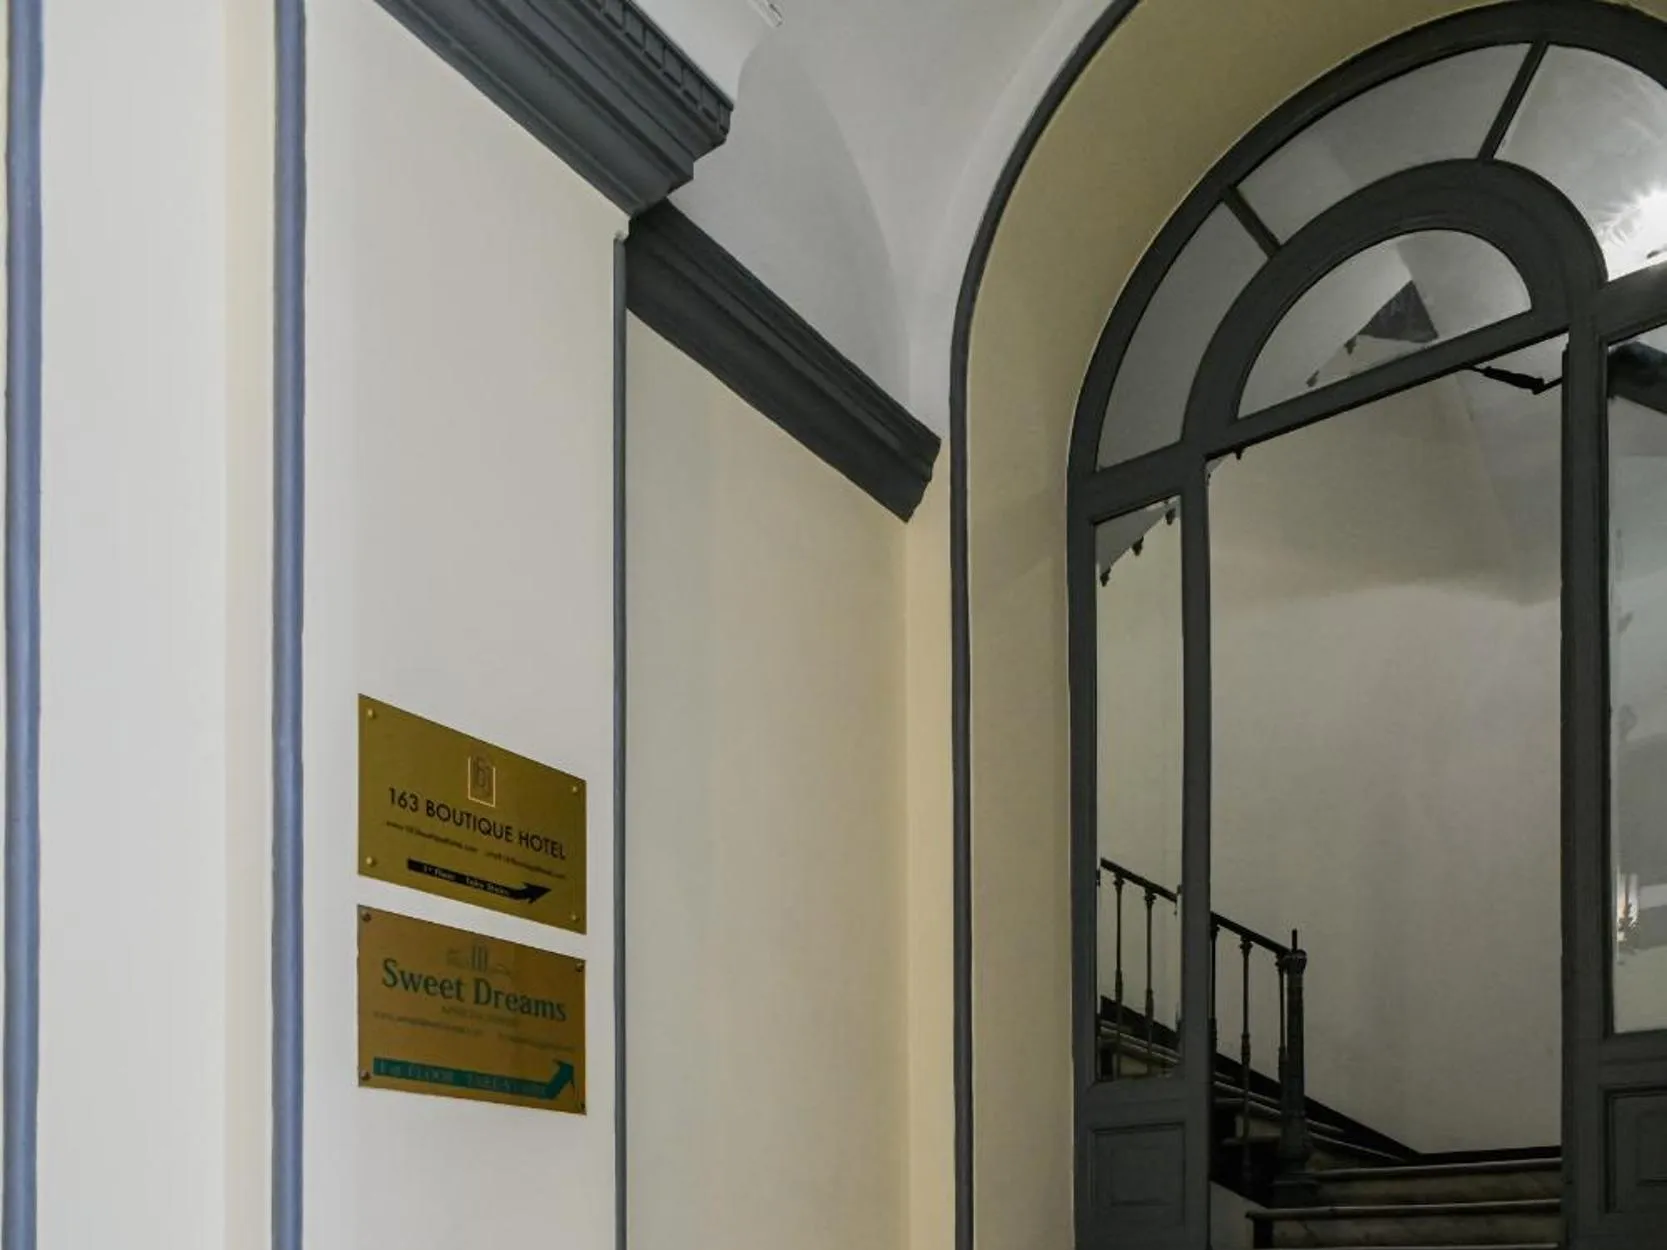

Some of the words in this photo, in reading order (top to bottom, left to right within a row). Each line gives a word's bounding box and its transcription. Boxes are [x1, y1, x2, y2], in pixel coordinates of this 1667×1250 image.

[388, 786, 420, 813] 163
[425, 798, 514, 843] BOUTIQUE
[518, 832, 567, 860] HOTEL
[382, 957, 466, 1003] Sweet
[473, 977, 568, 1023] Dreams
